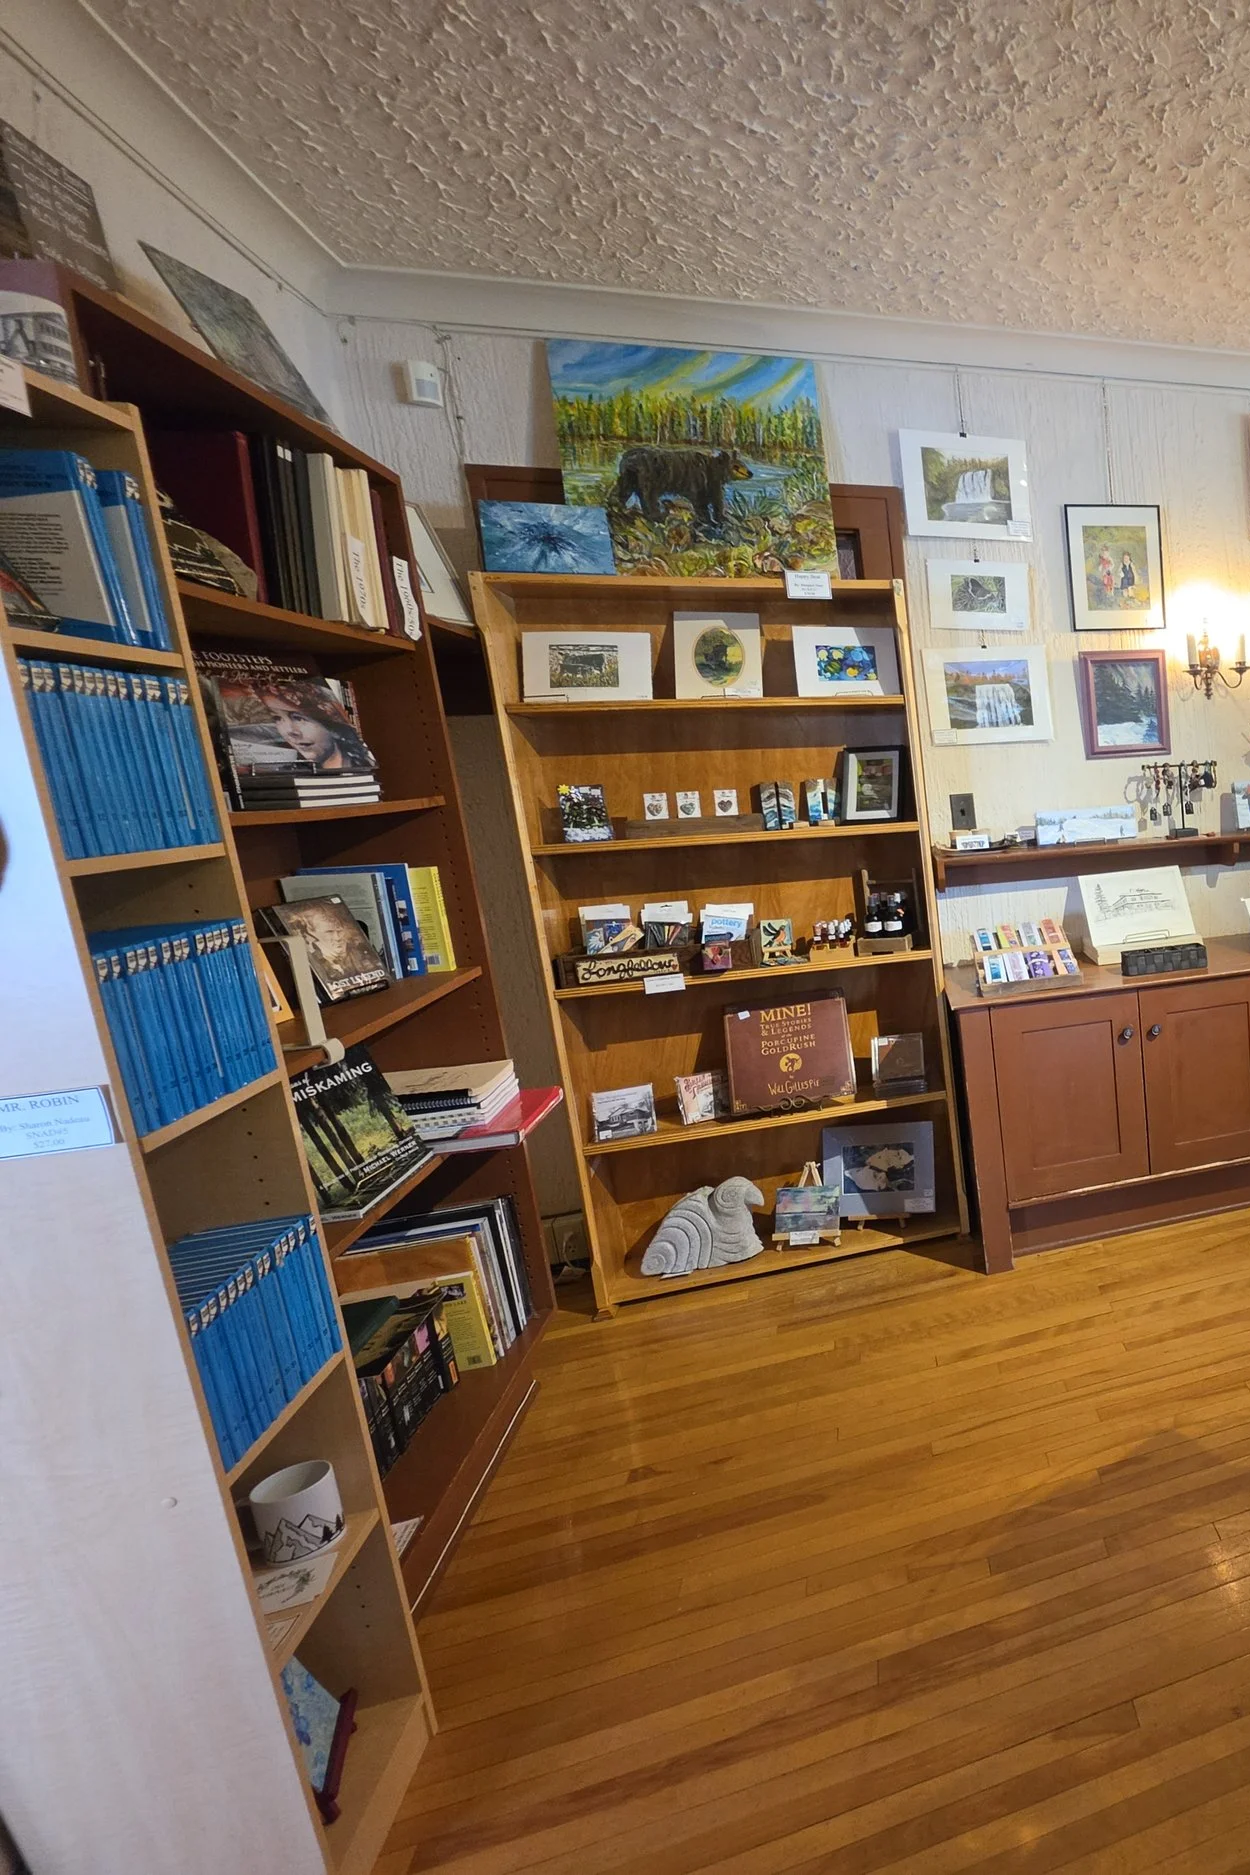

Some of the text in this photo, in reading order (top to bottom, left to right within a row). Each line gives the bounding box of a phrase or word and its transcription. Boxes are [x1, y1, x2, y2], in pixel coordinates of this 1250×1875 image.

[396, 562, 404, 582] The
[352, 551, 367, 609] The 1970s
[203, 651, 272, 665] FOOTSTEPS
[206, 661, 249, 671] PIONEERS
[250, 662, 270, 672] AND
[270, 665, 308, 674] SETTLERS
[711, 918, 742, 928] pottery
[581, 958, 674, 982] Longfellow
[326, 978, 350, 991] LOST
[760, 1003, 811, 1022] MINE!
[771, 1024, 812, 1035] LEGENDS
[761, 1034, 816, 1048] PORCUPINE
[29, 1095, 79, 1110] ROBIN
[19, 1120, 52, 1131] Sharon
[363, 1155, 391, 1174] MICHAEL
[390, 1140, 418, 1158] WERNER
